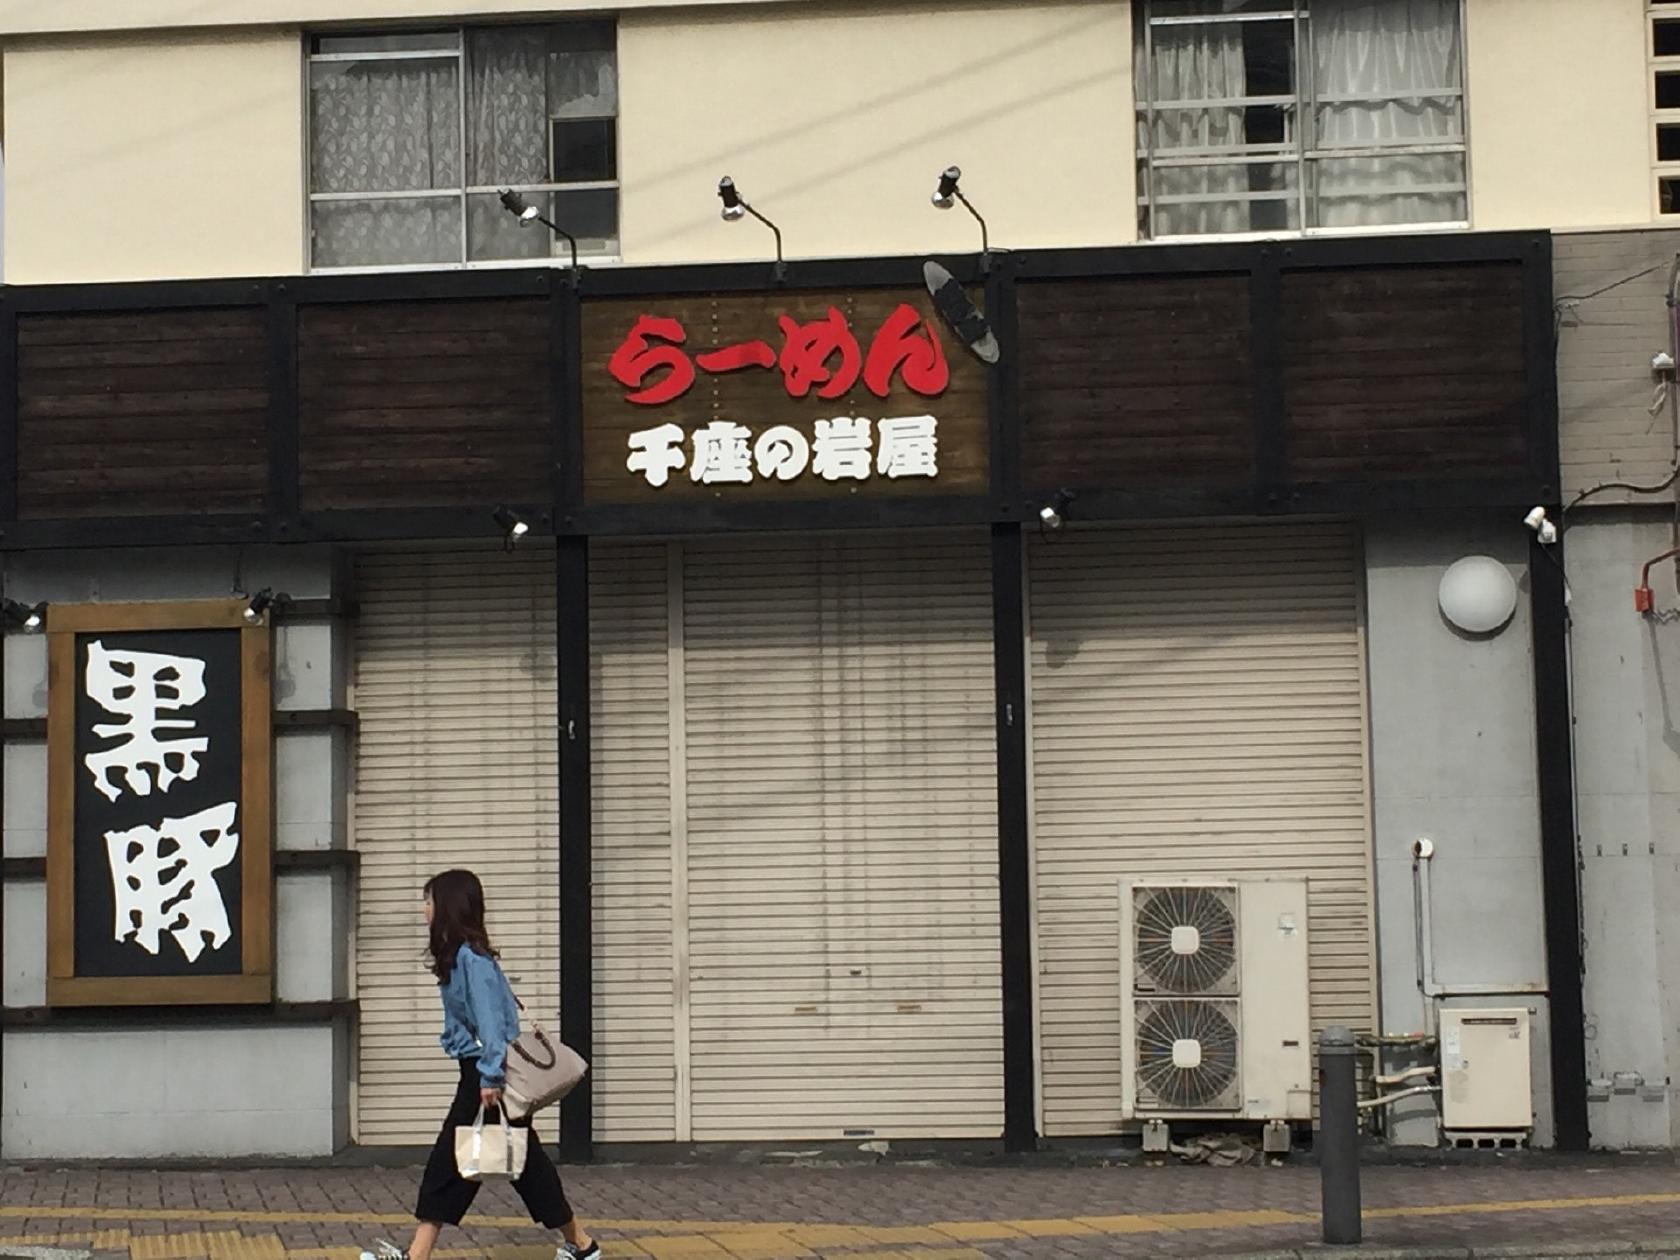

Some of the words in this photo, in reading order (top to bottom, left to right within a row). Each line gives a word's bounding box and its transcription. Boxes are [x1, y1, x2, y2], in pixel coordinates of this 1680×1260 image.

[608, 303, 950, 405] らーめん
[626, 415, 939, 487] 千座の岩屋
[84, 640, 239, 963] 黒豚
